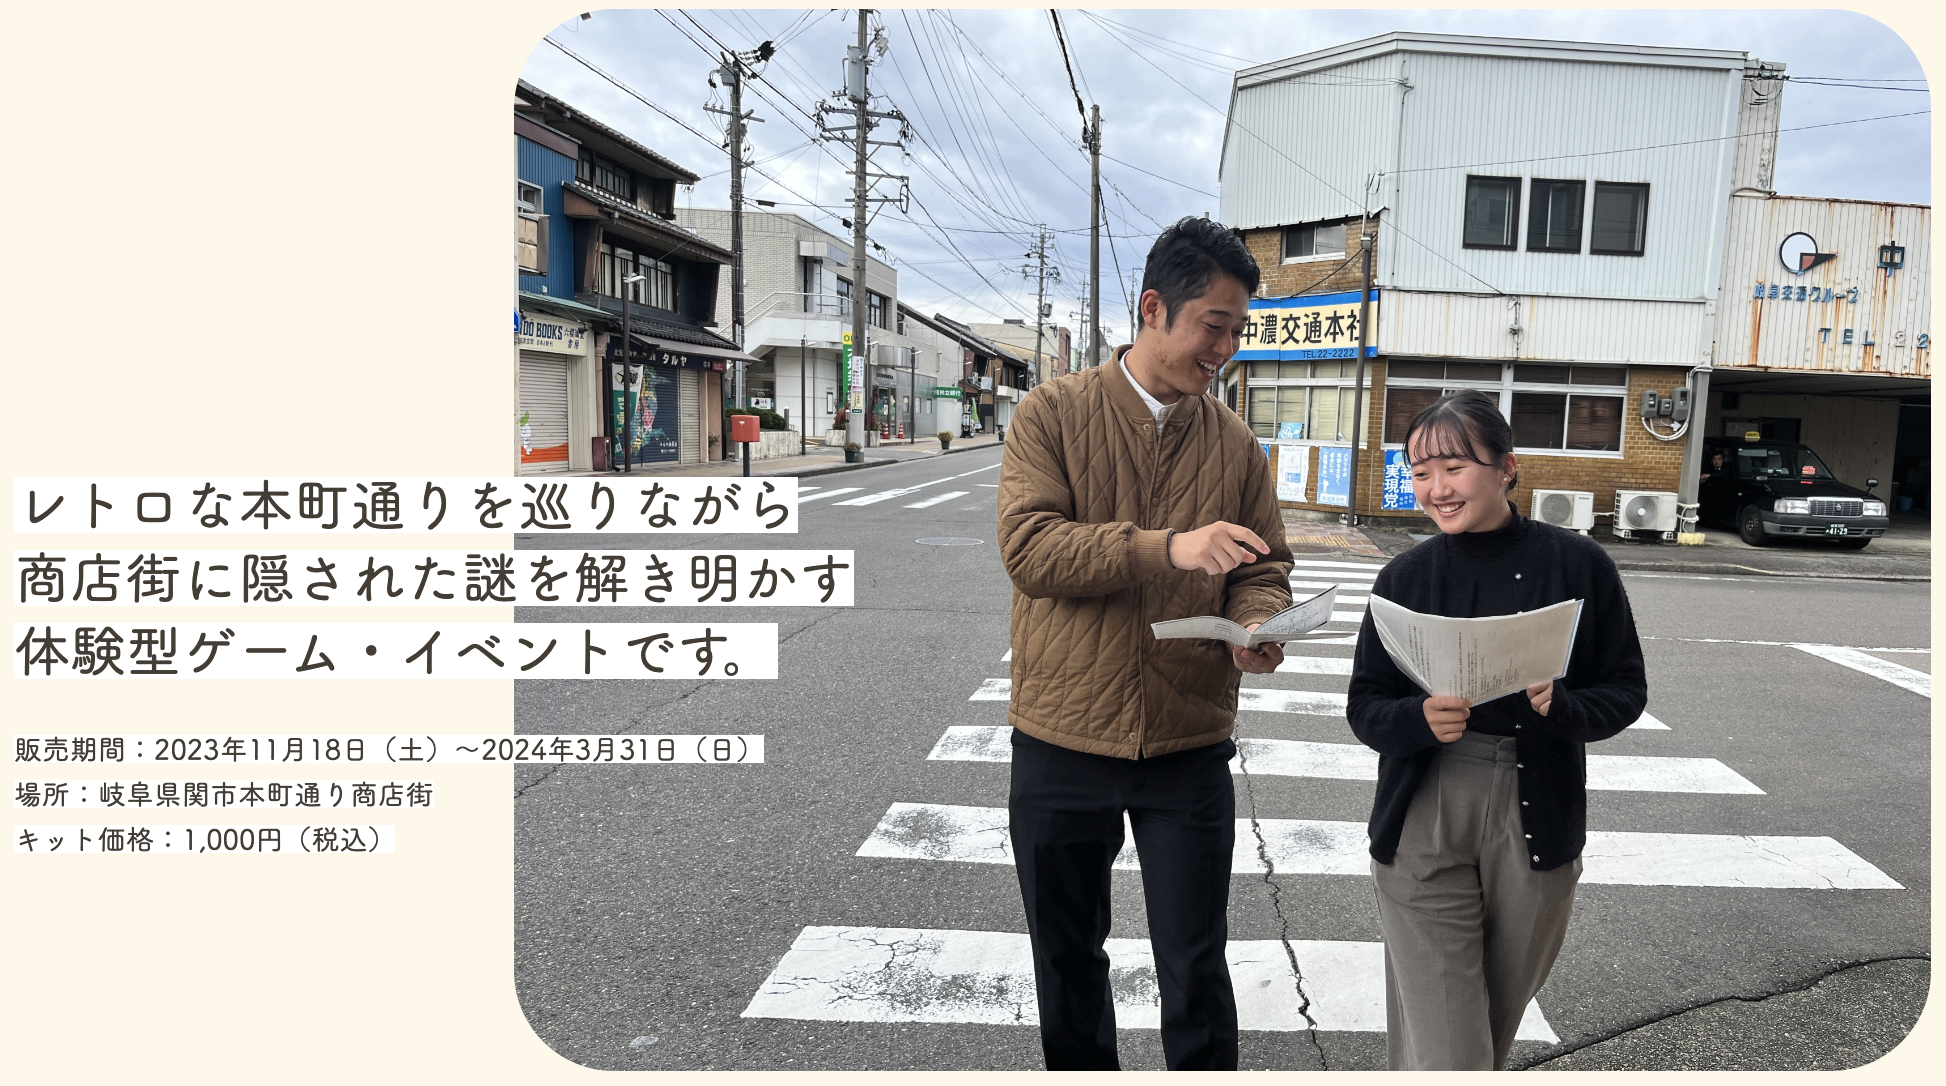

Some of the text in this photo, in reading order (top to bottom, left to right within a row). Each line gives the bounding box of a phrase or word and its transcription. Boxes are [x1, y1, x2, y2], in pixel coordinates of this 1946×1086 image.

[1877, 241, 1905, 277] 中
[536, 322, 563, 340] BOOKS
[1241, 309, 1361, 345] 中濃交通本社
[1819, 328, 1875, 346] TEL
[662, 352, 687, 367] タルヤ
[1302, 348, 1355, 359] TEL 22-2222
[1384, 463, 1400, 508] 実現党
[1400, 465, 1414, 494] 幸福
